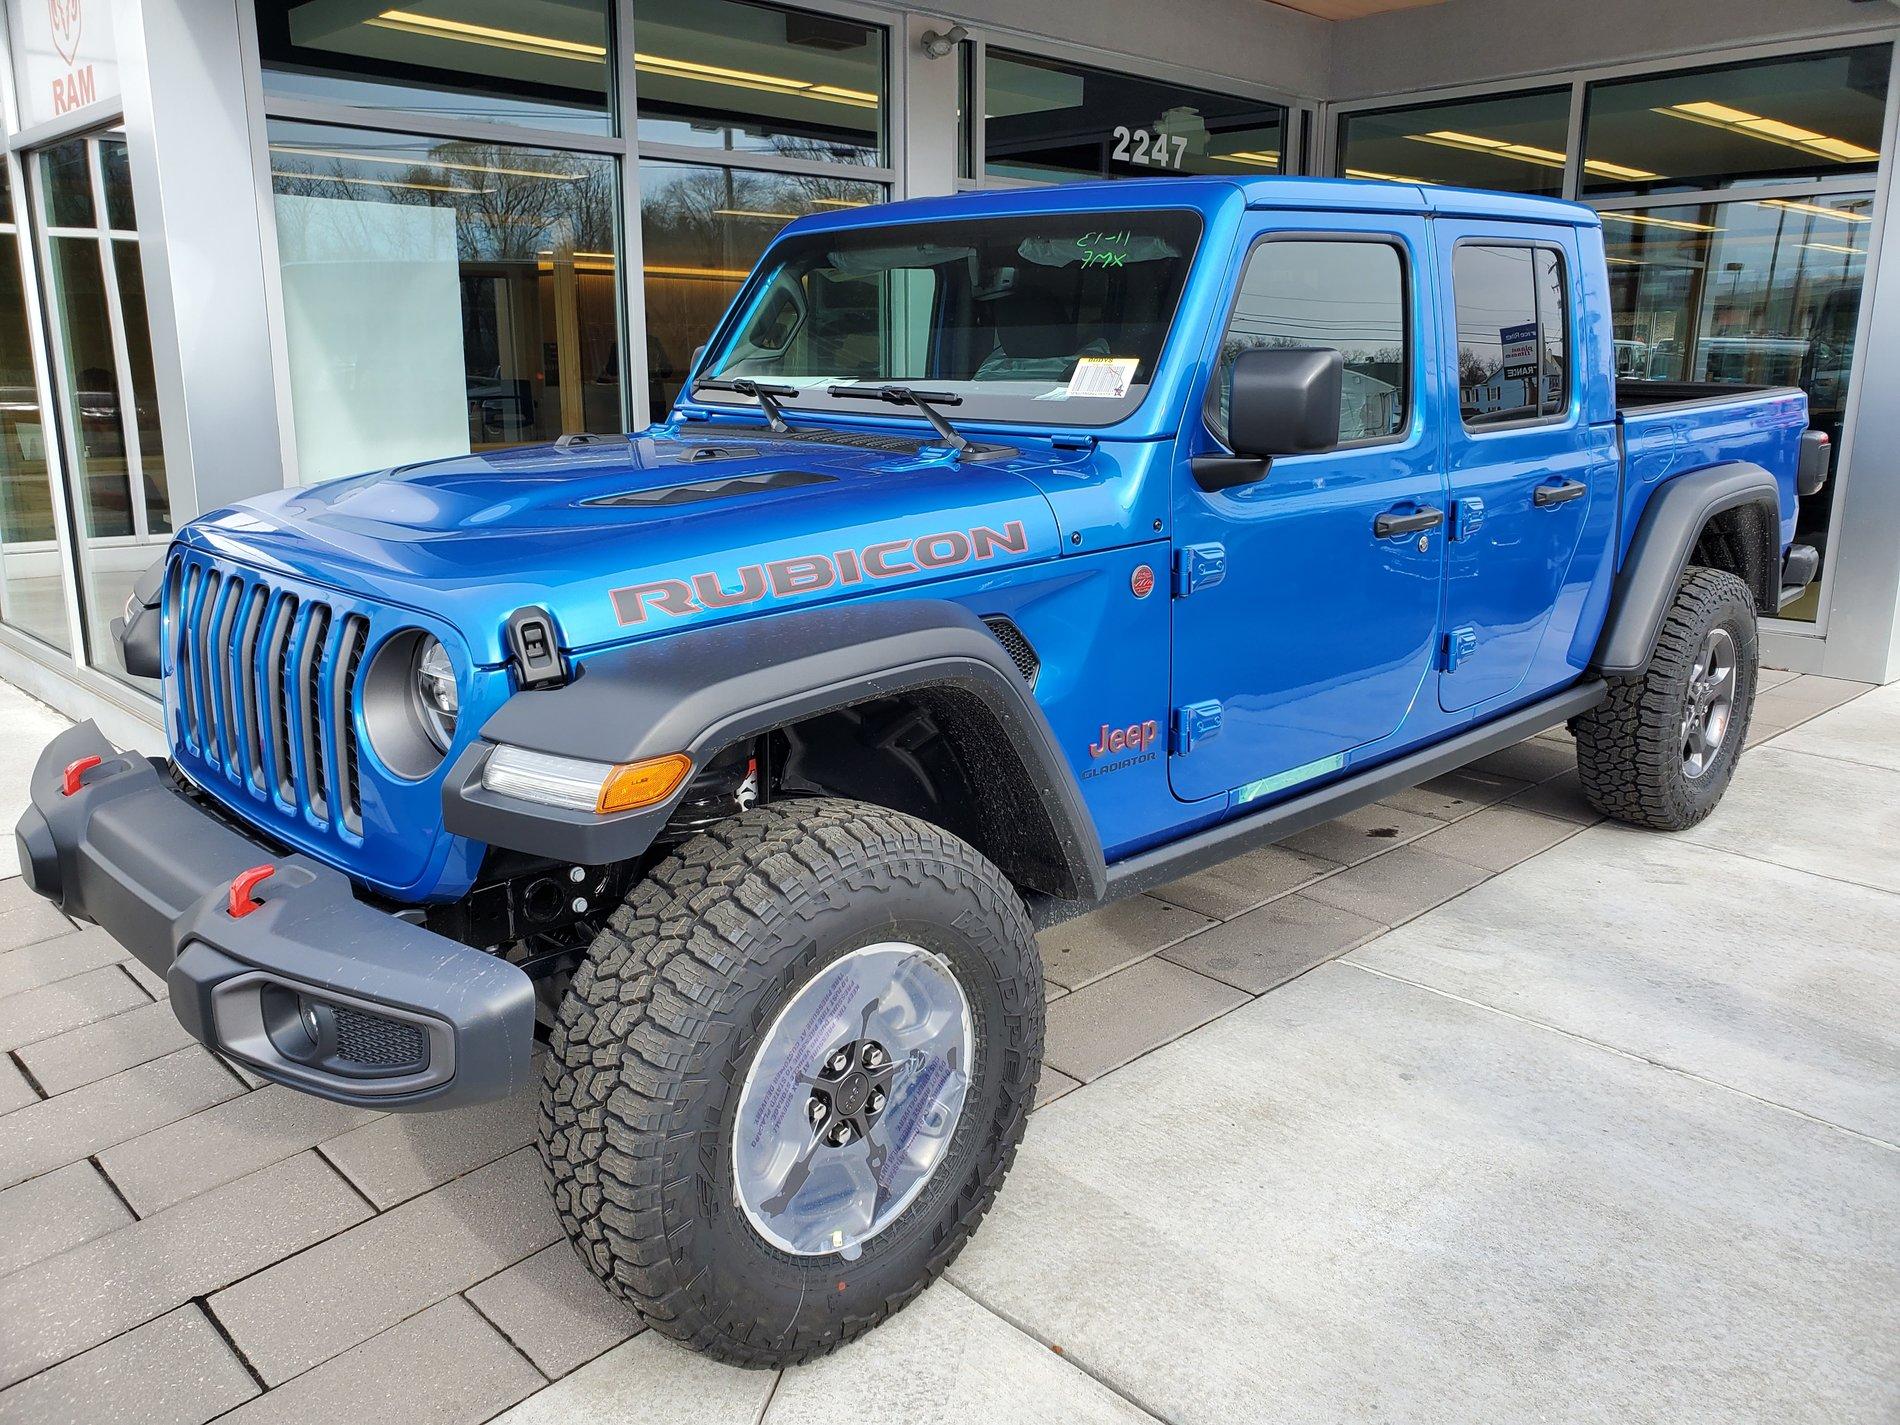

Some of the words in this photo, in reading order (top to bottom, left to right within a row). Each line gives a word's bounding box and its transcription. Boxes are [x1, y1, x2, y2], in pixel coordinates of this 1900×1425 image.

[52, 64, 97, 115] RAM
[1112, 126, 1187, 169] 2247
[608, 520, 1029, 627] RUBICON
[1089, 720, 1157, 758] Jeep
[1082, 752, 1157, 779] GLADIATOR
